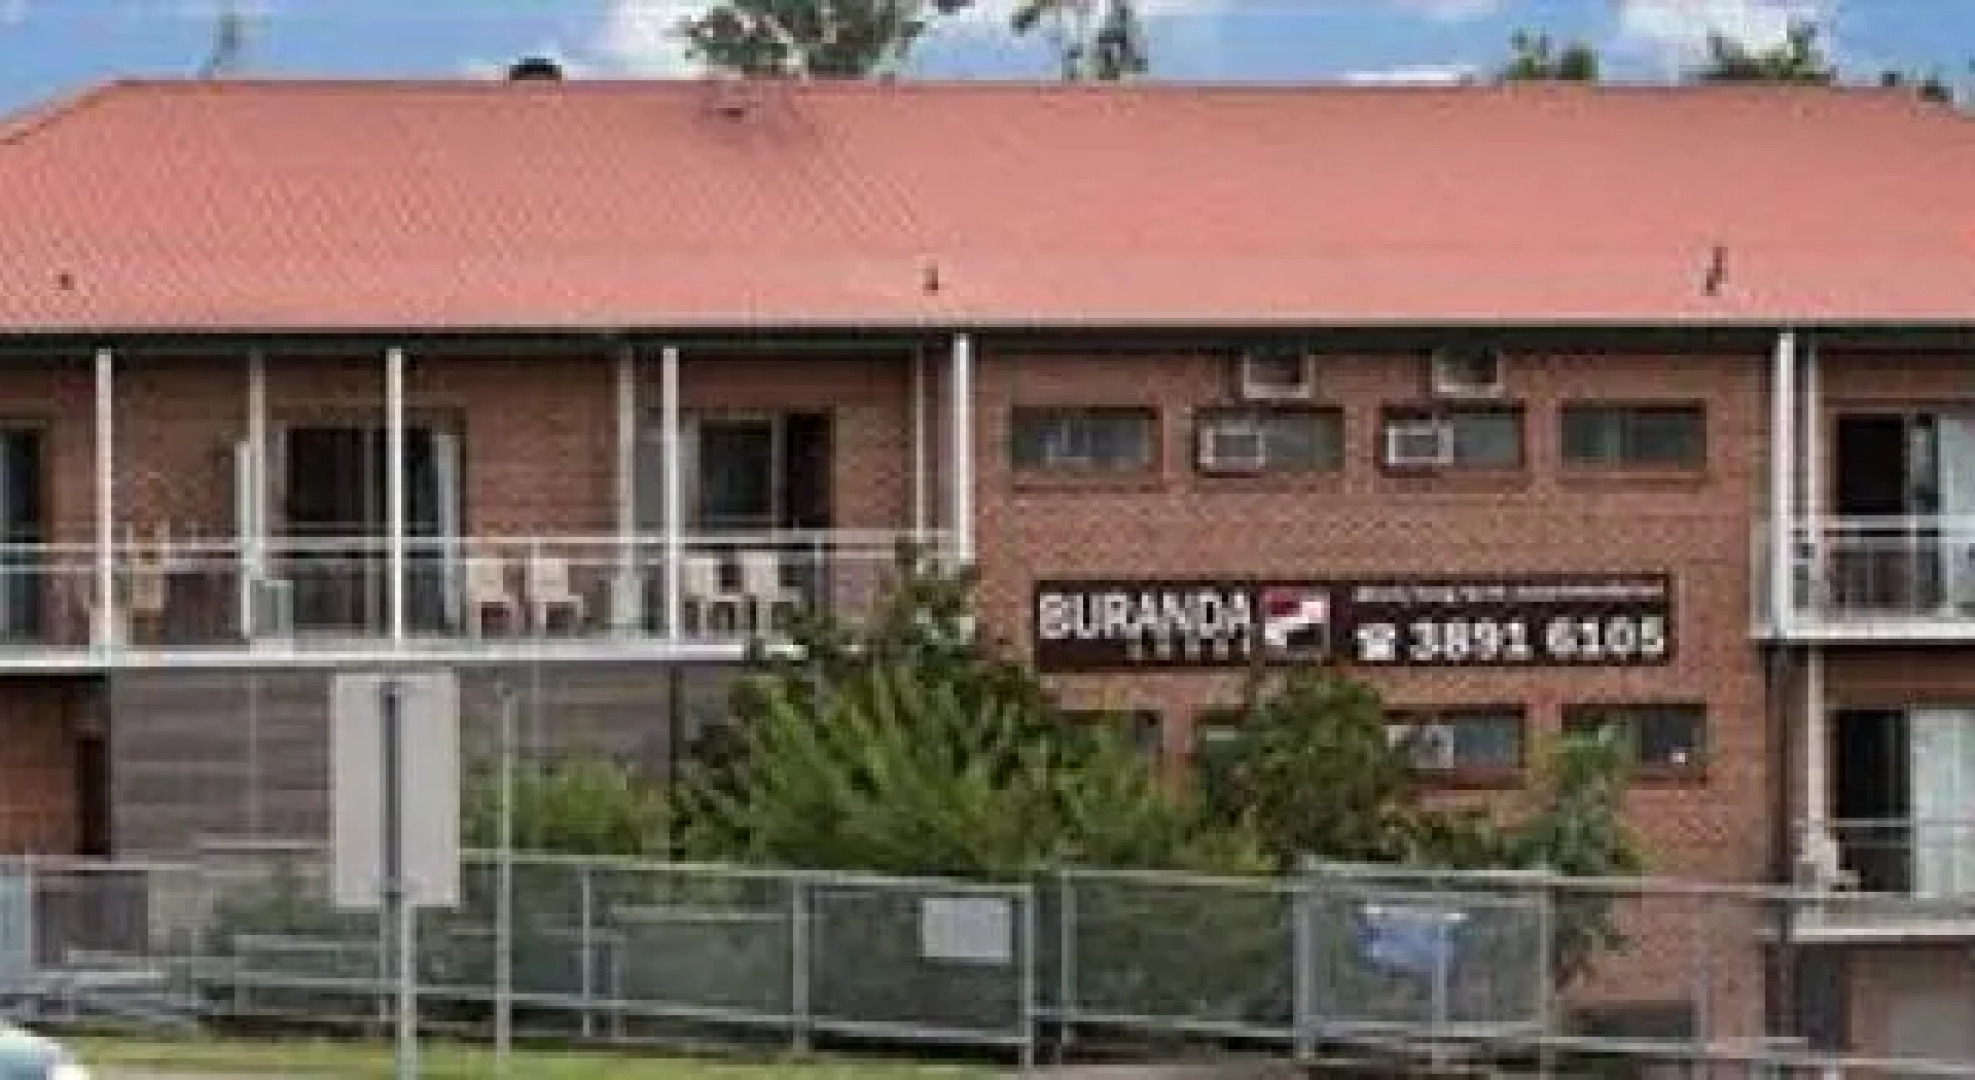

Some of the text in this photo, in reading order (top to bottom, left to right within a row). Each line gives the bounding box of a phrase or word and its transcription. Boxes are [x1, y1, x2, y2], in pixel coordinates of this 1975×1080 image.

[1040, 591, 1251, 638] BURANDA
[1409, 616, 1665, 661] 3891 6105
